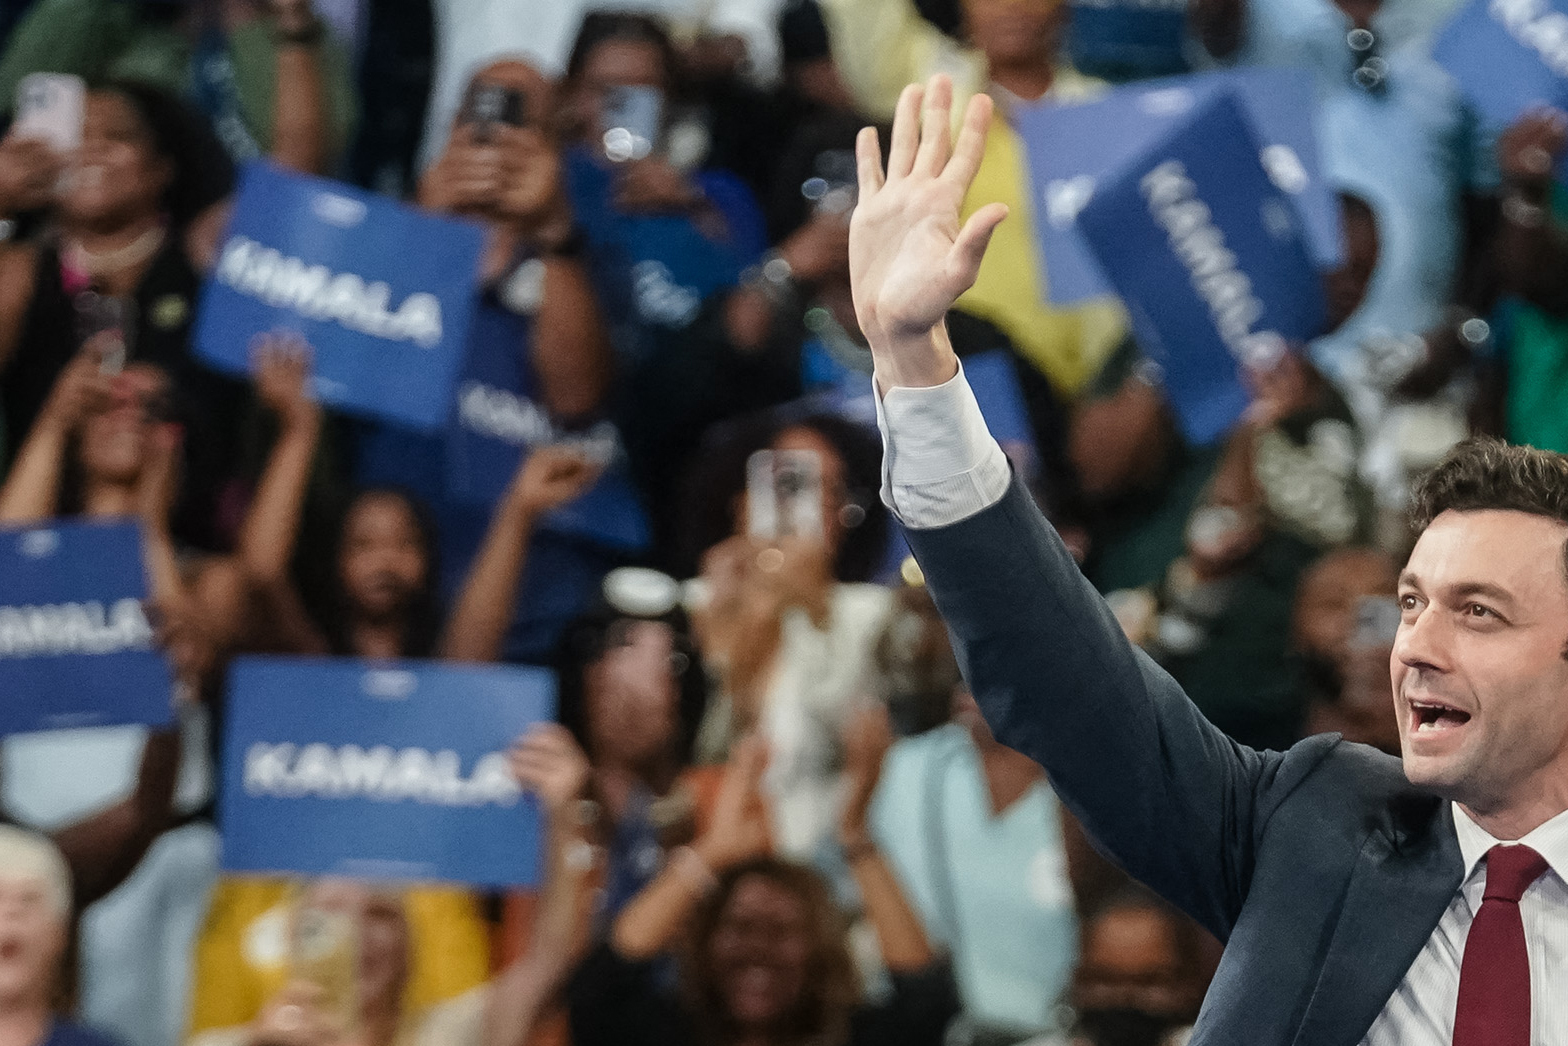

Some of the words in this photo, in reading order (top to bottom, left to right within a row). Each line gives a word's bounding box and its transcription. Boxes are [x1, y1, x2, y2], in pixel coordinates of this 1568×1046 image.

[218, 236, 443, 348] KAMALA
[1140, 159, 1289, 371] KAMALA
[0, 598, 154, 657] AMALA
[244, 742, 521, 808] KAMALA
